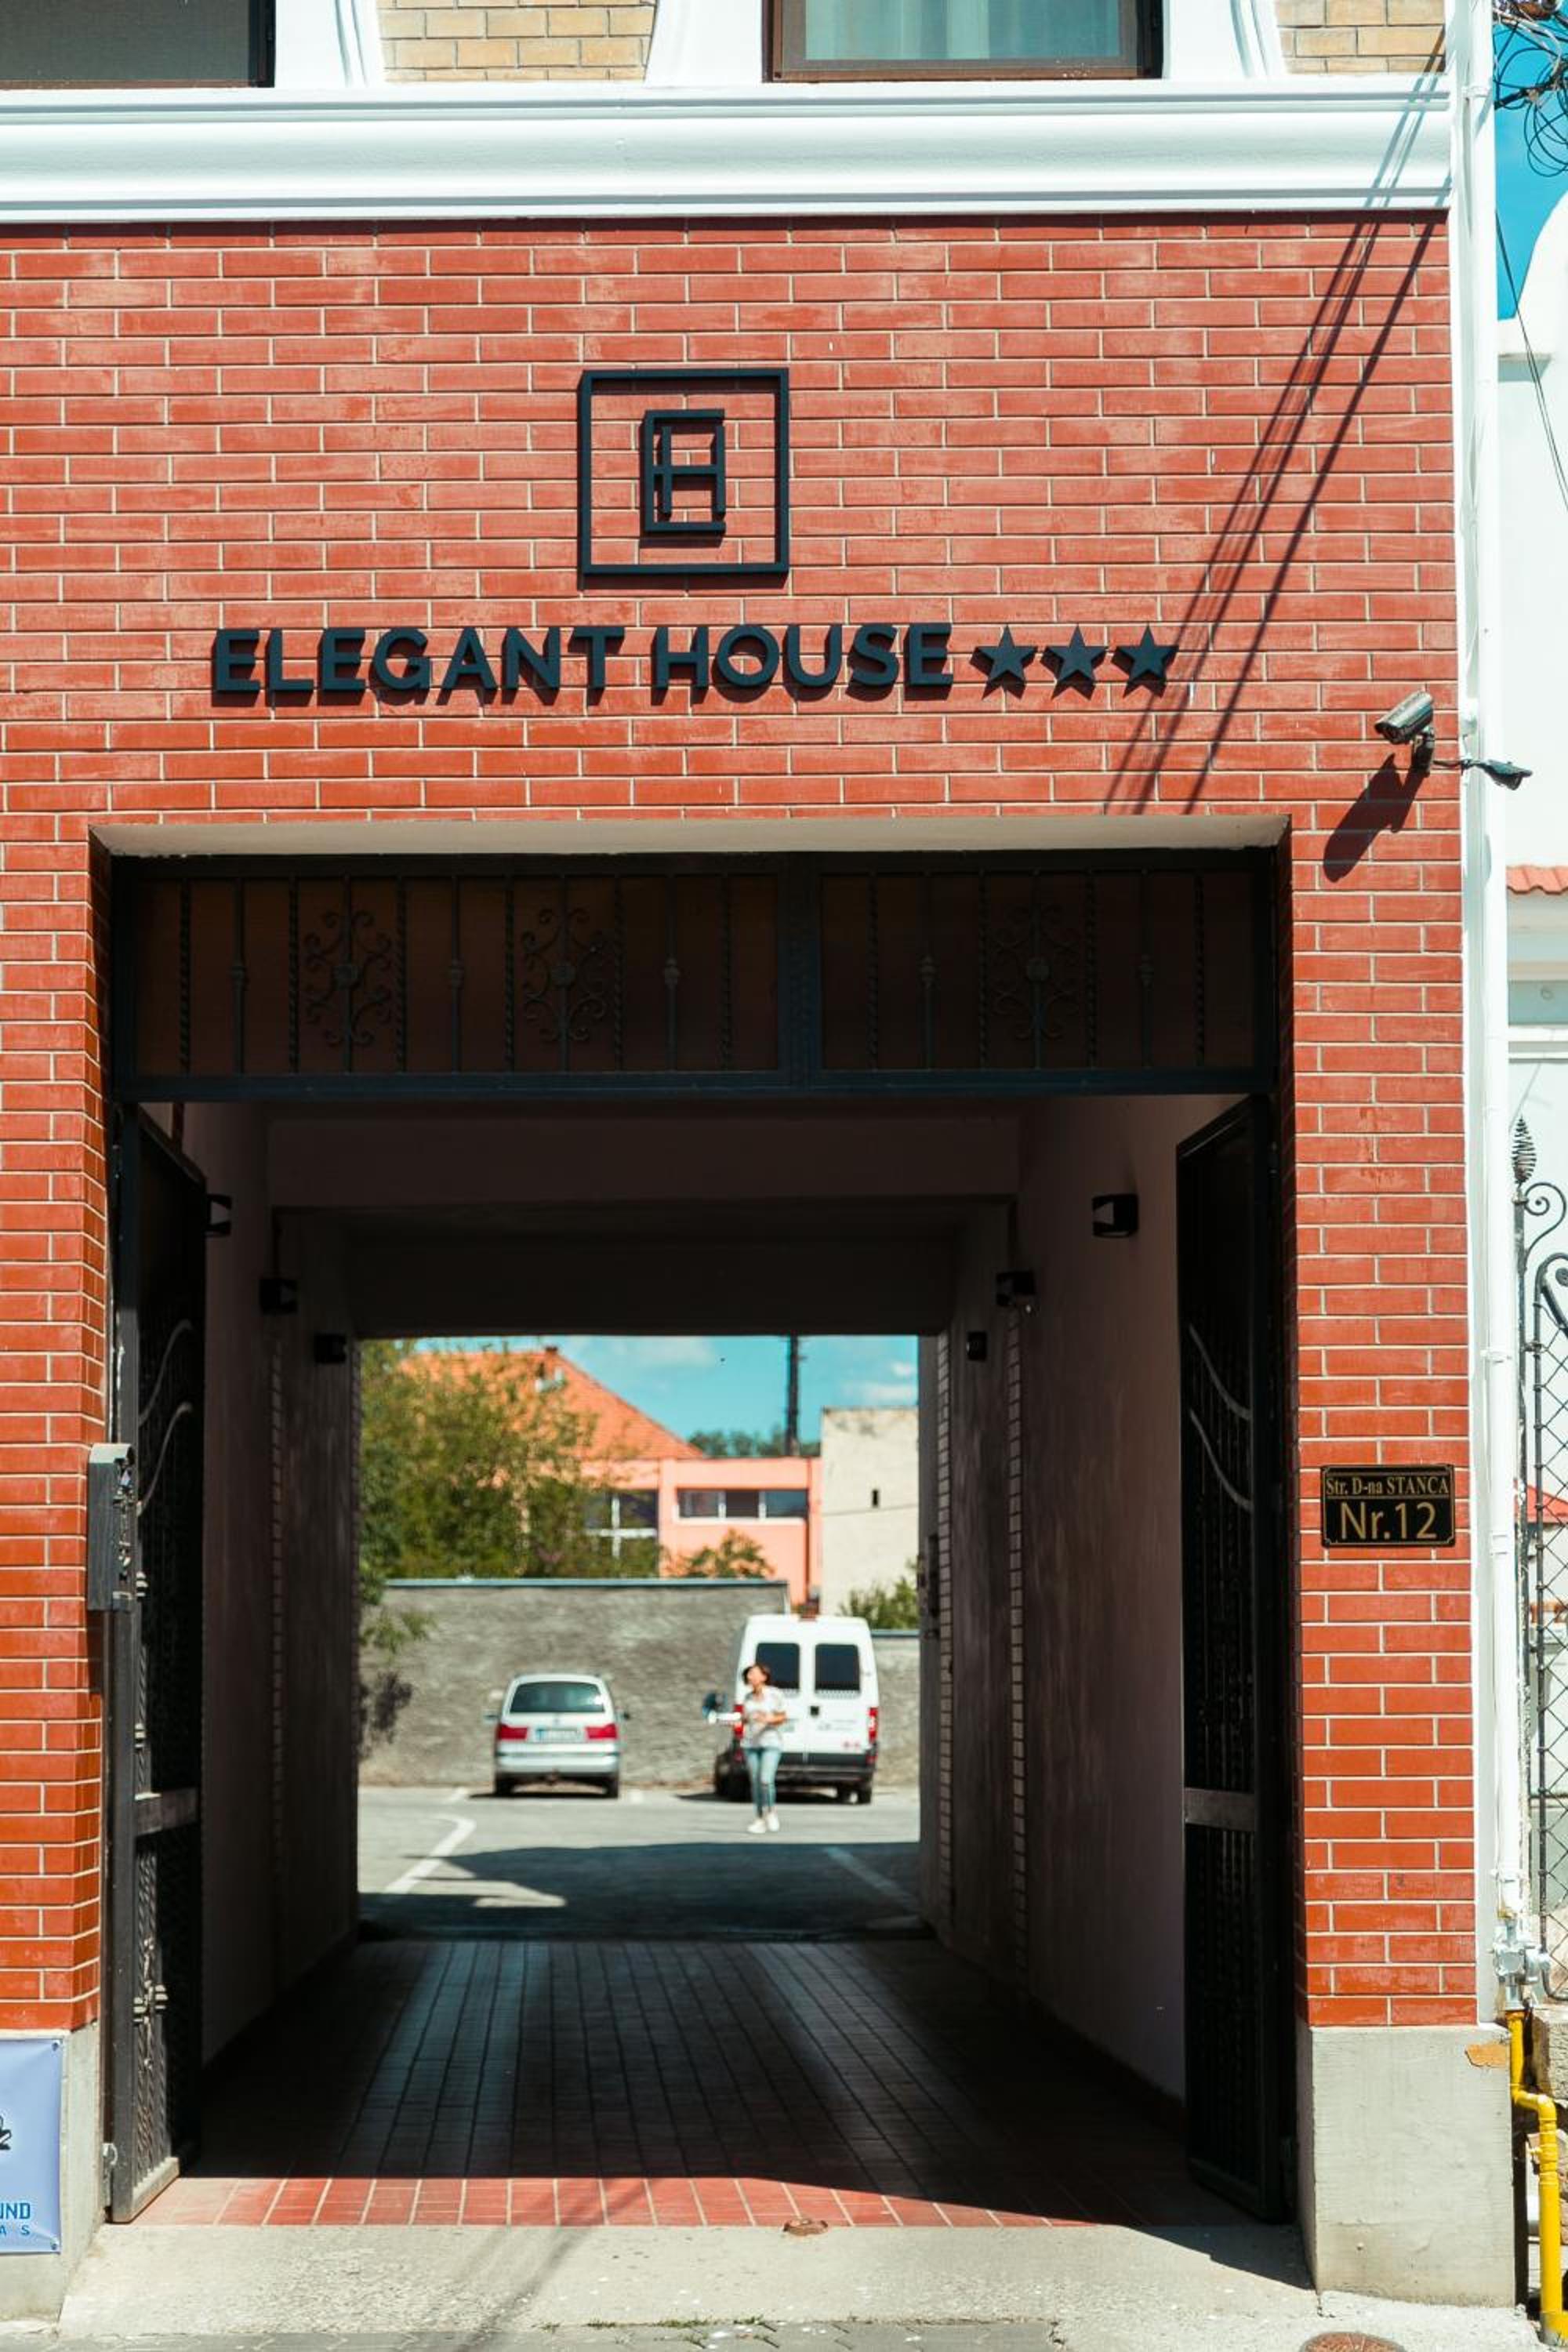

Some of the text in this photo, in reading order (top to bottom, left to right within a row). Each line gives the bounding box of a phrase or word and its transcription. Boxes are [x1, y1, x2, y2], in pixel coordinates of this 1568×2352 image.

[212, 622, 954, 693] ELEGANT HOUSE
[1326, 1476, 1449, 1495] Str. D-na STANCA
